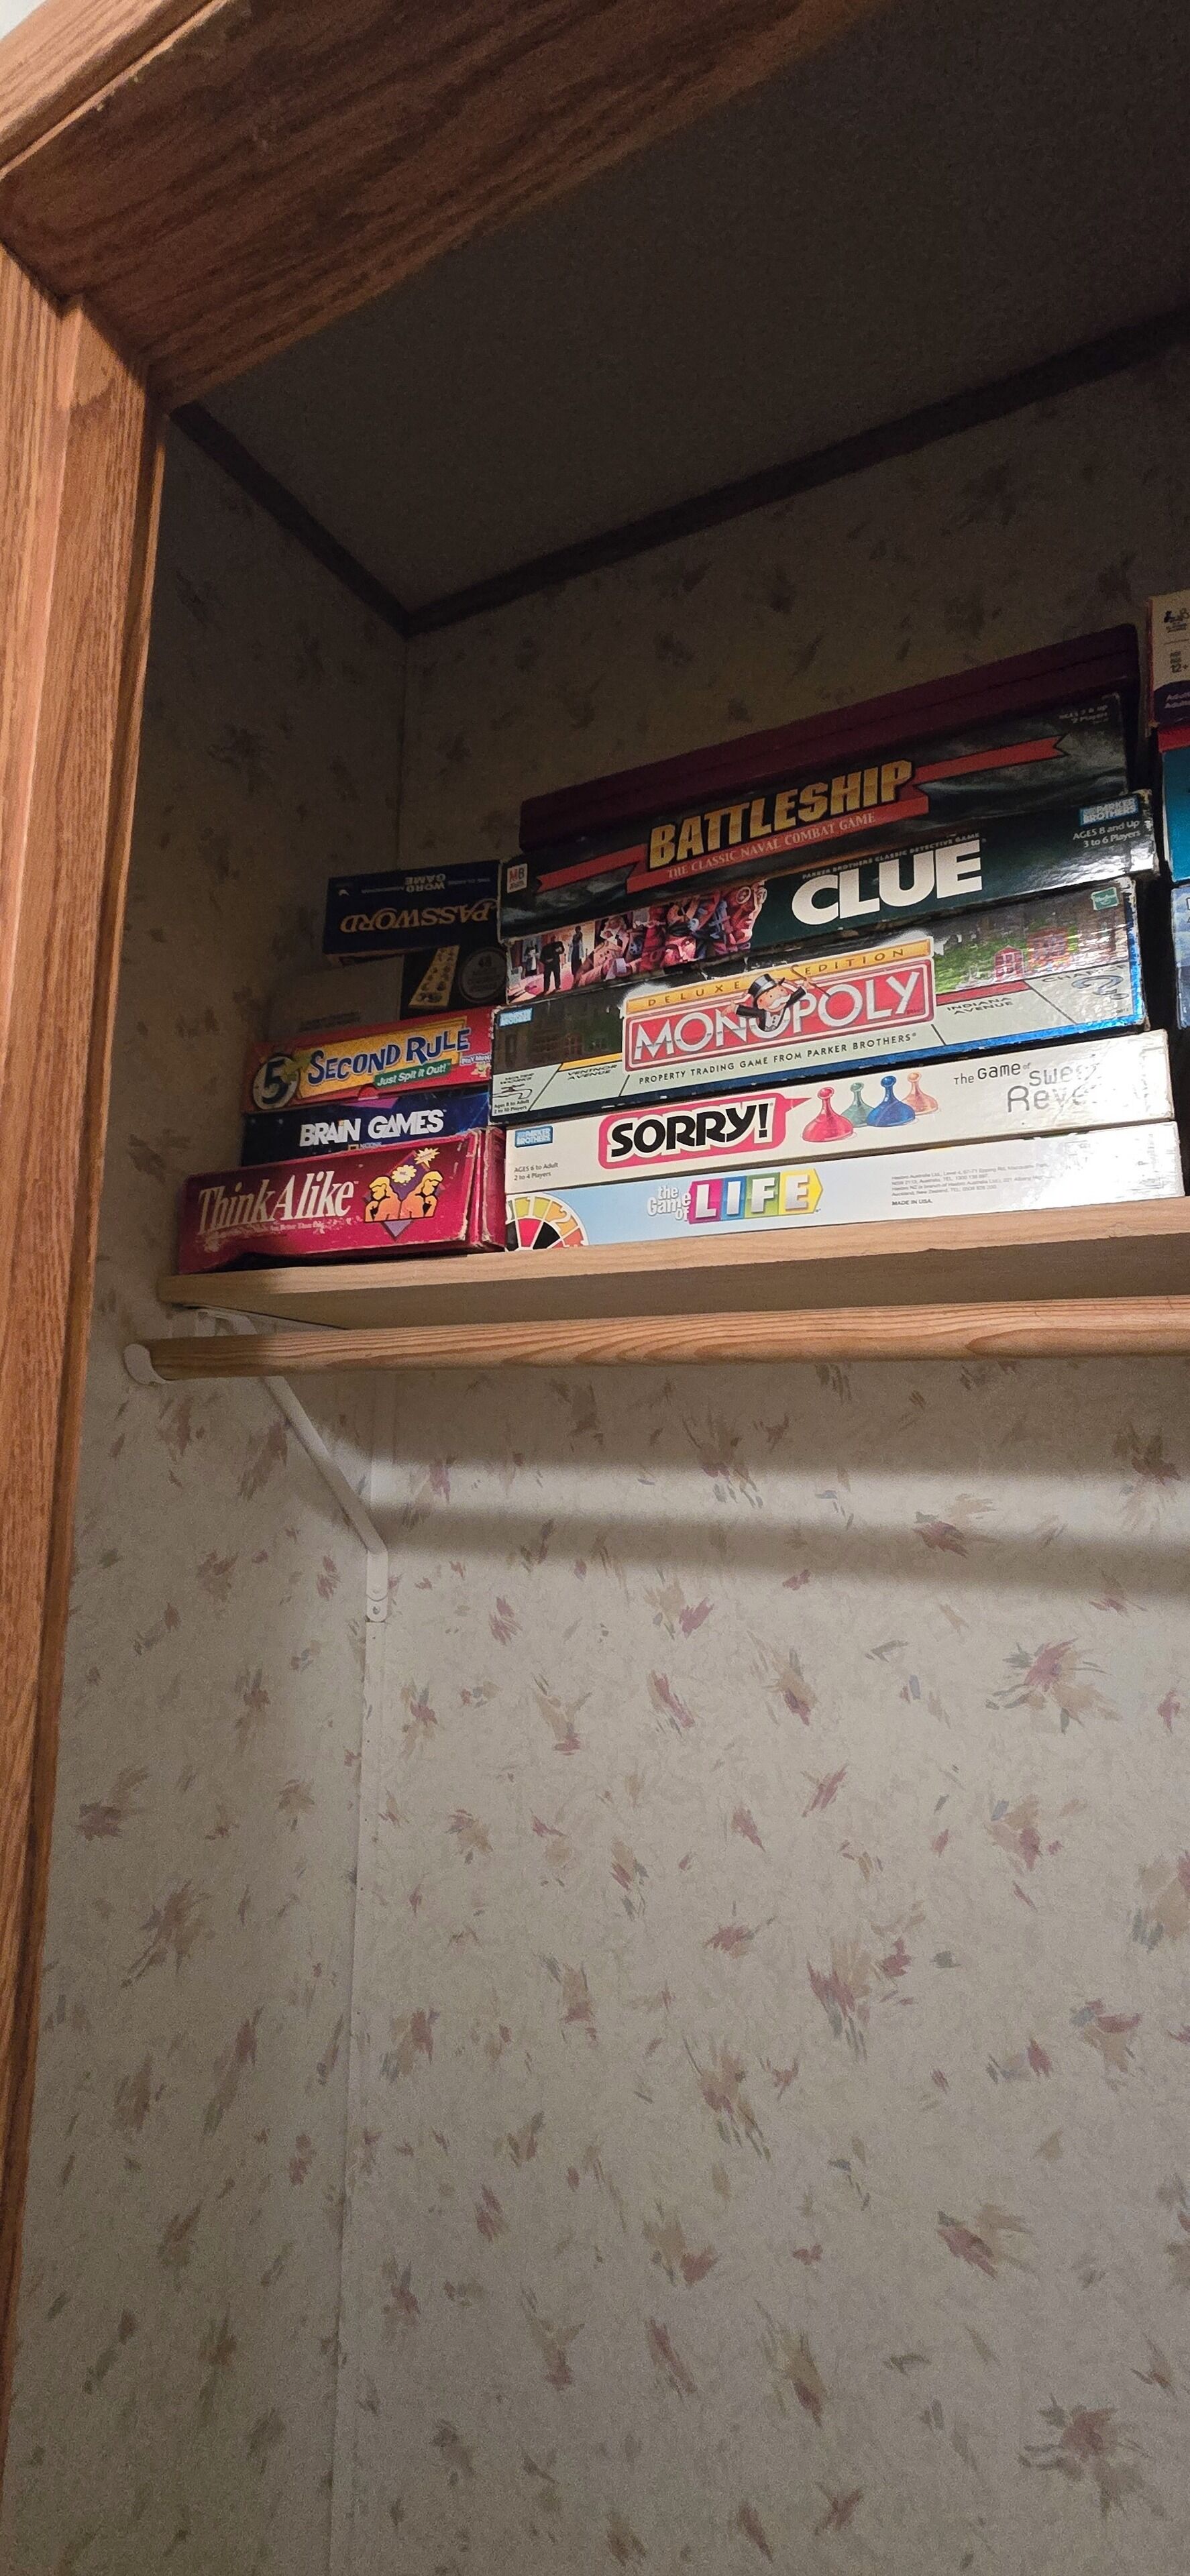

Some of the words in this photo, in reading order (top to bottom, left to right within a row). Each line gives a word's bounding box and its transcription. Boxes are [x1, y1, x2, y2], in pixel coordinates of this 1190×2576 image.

[649, 760, 912, 869] BATTLESHIP
[668, 866, 688, 879] THE
[691, 851, 736, 871] CLASSIC
[741, 840, 781, 857] NAVAL
[784, 824, 835, 845] COMBAT
[840, 812, 875, 830] GAME
[1073, 828, 1097, 840] AGES
[1107, 822, 1125, 833] and
[1083, 840, 1089, 848] 3
[1102, 836, 1109, 844] 6
[1110, 830, 1140, 843] Players
[802, 867, 830, 879] PARKER
[832, 858, 873, 872] BROTHERS
[875, 850, 908, 862] CLASSIC
[910, 839, 953, 854] DETECTIVE
[955, 833, 979, 843] GAME
[406, 881, 445, 894] WORD
[792, 839, 983, 926] CLUE
[339, 898, 498, 933] PASSWORD
[647, 981, 740, 1007] DELUXE
[804, 948, 904, 975] EDITION
[946, 997, 1012, 1011] INDIANA
[954, 1001, 1014, 1015] AVENUE
[261, 1059, 292, 1106] 5
[308, 1044, 400, 1085] SECOND
[406, 1029, 470, 1065] RULE
[377, 1075, 397, 1087] Just
[398, 1070, 417, 1083] Spit
[418, 1069, 425, 1077] it
[426, 1064, 447, 1075] Out!
[567, 1069, 611, 1080] AVENUE
[639, 1070, 686, 1085] PROPERTY
[691, 1062, 735, 1076] TRADING
[739, 1057, 769, 1068] GAME
[773, 1052, 802, 1064] FROM
[807, 1044, 848, 1058] PARKER
[953, 1073, 975, 1085] The
[977, 1063, 1022, 1081] Game
[1023, 1062, 1032, 1070] of
[299, 1118, 362, 1147] BRAIN
[368, 1109, 444, 1139] GAMES
[610, 1102, 771, 1158] SORRY!
[531, 1171, 551, 1179] Players
[647, 1191, 692, 1216] Game
[657, 1184, 679, 1199] the
[675, 1208, 690, 1221] of
[695, 1174, 810, 1219] LIFE
